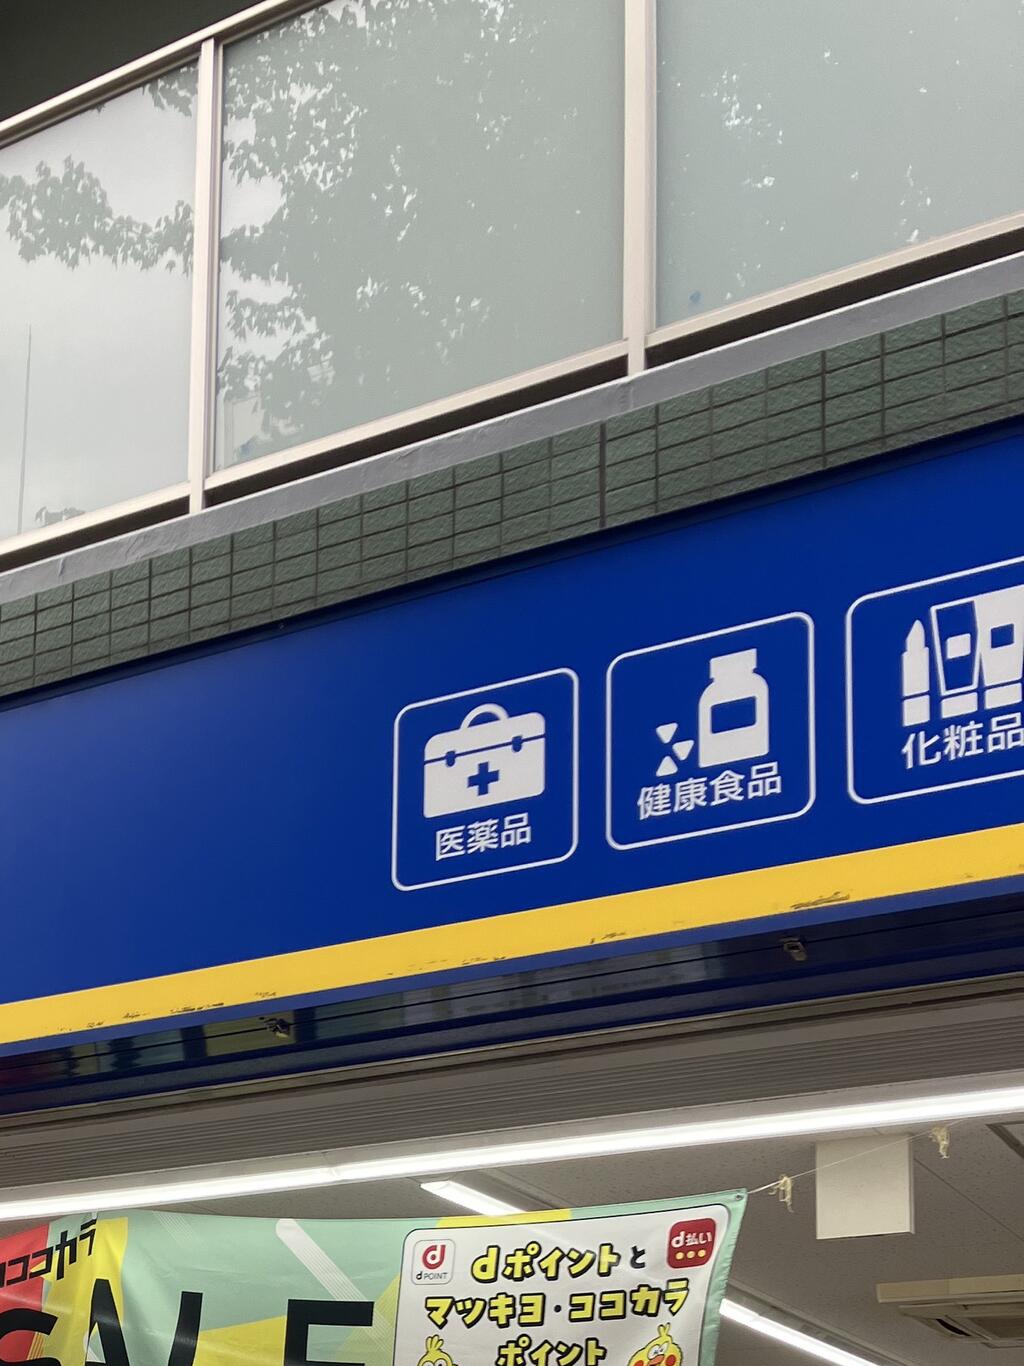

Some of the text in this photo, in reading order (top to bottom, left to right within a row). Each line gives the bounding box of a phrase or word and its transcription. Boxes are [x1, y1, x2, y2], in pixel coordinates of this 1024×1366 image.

[902, 713, 1024, 770] 化粧品
[636, 761, 782, 821] 健康食品
[435, 812, 532, 862] 医薬品
[470, 1240, 646, 1287] dポイントと
[671, 1229, 713, 1249] d払い
[424, 1278, 691, 1330] マツキヨ・ココカラ
